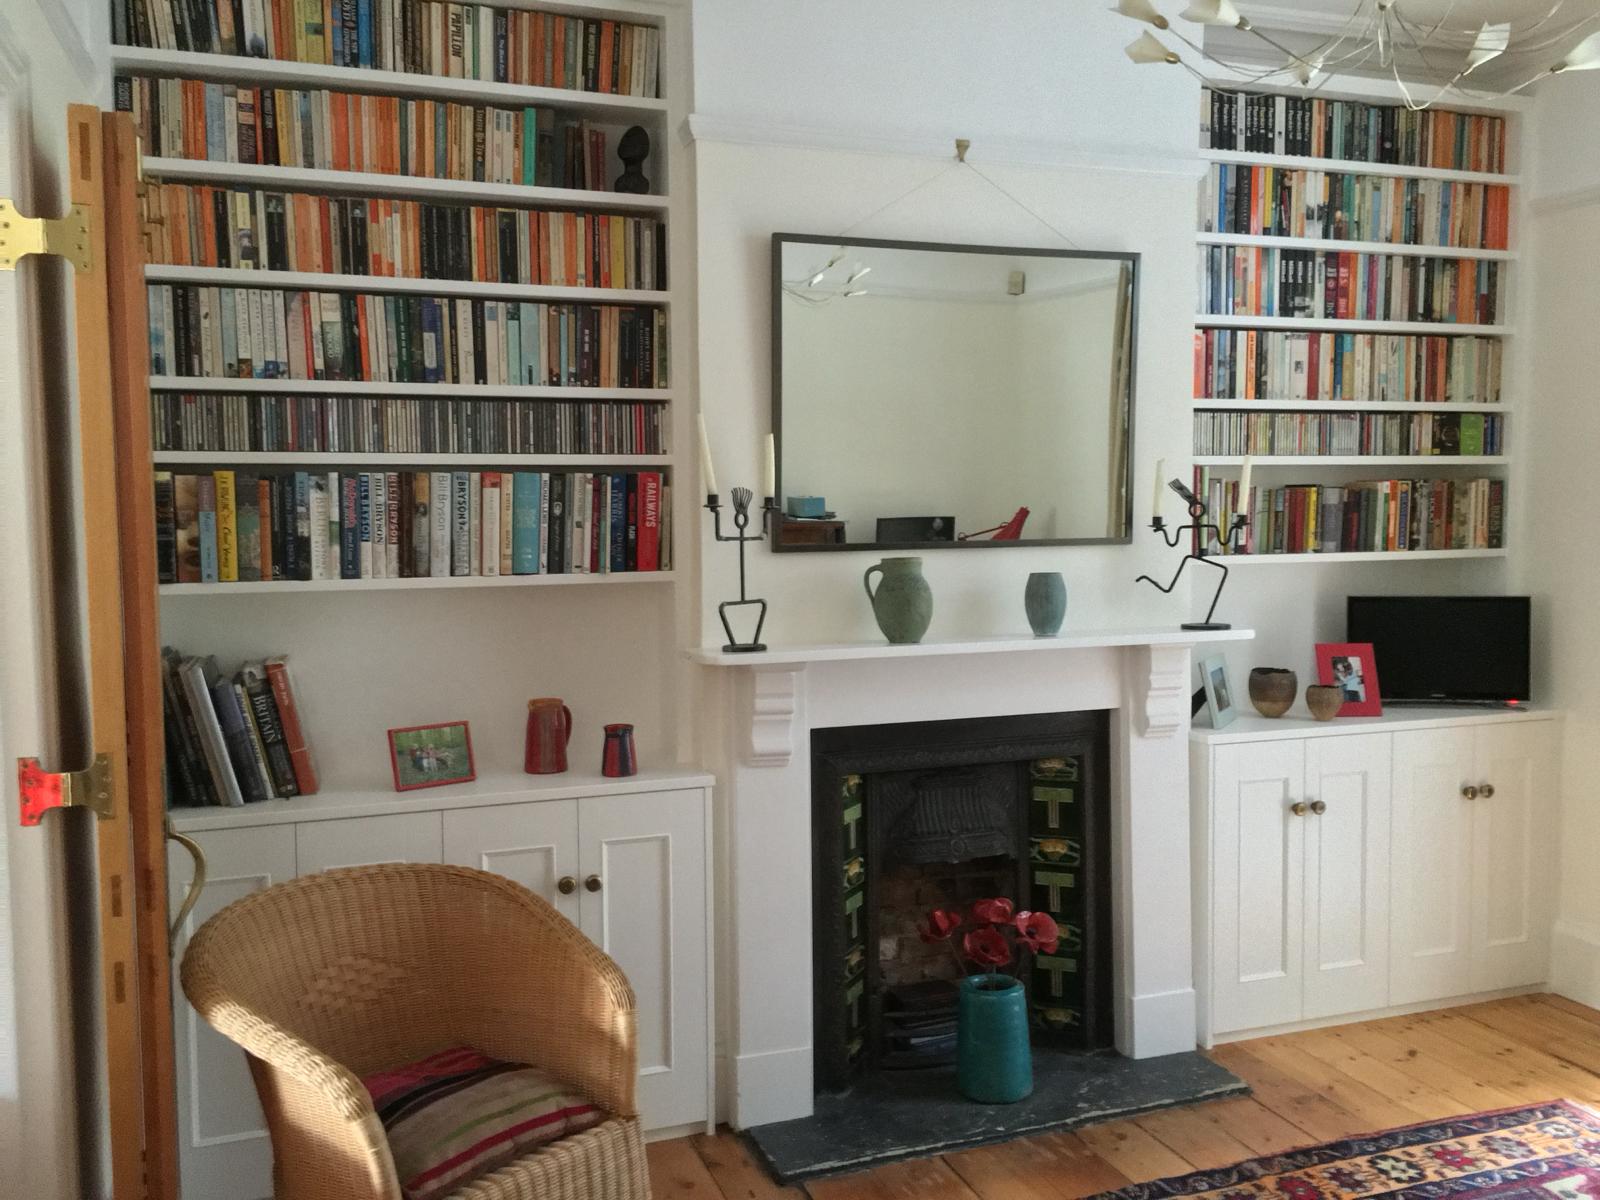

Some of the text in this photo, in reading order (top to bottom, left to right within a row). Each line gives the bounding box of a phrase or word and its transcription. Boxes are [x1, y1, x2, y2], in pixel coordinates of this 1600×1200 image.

[451, 13, 462, 58] PAPILLON
[438, 475, 449, 491] Bill
[646, 482, 657, 528] RAILWAYS
[360, 476, 369, 541] BILL BRYSON
[375, 478, 384, 544] BILL BRYSON
[388, 476, 398, 543] BILL BRYSON
[436, 494, 449, 531] Bryson
[254, 695, 277, 744] BRITAIN
